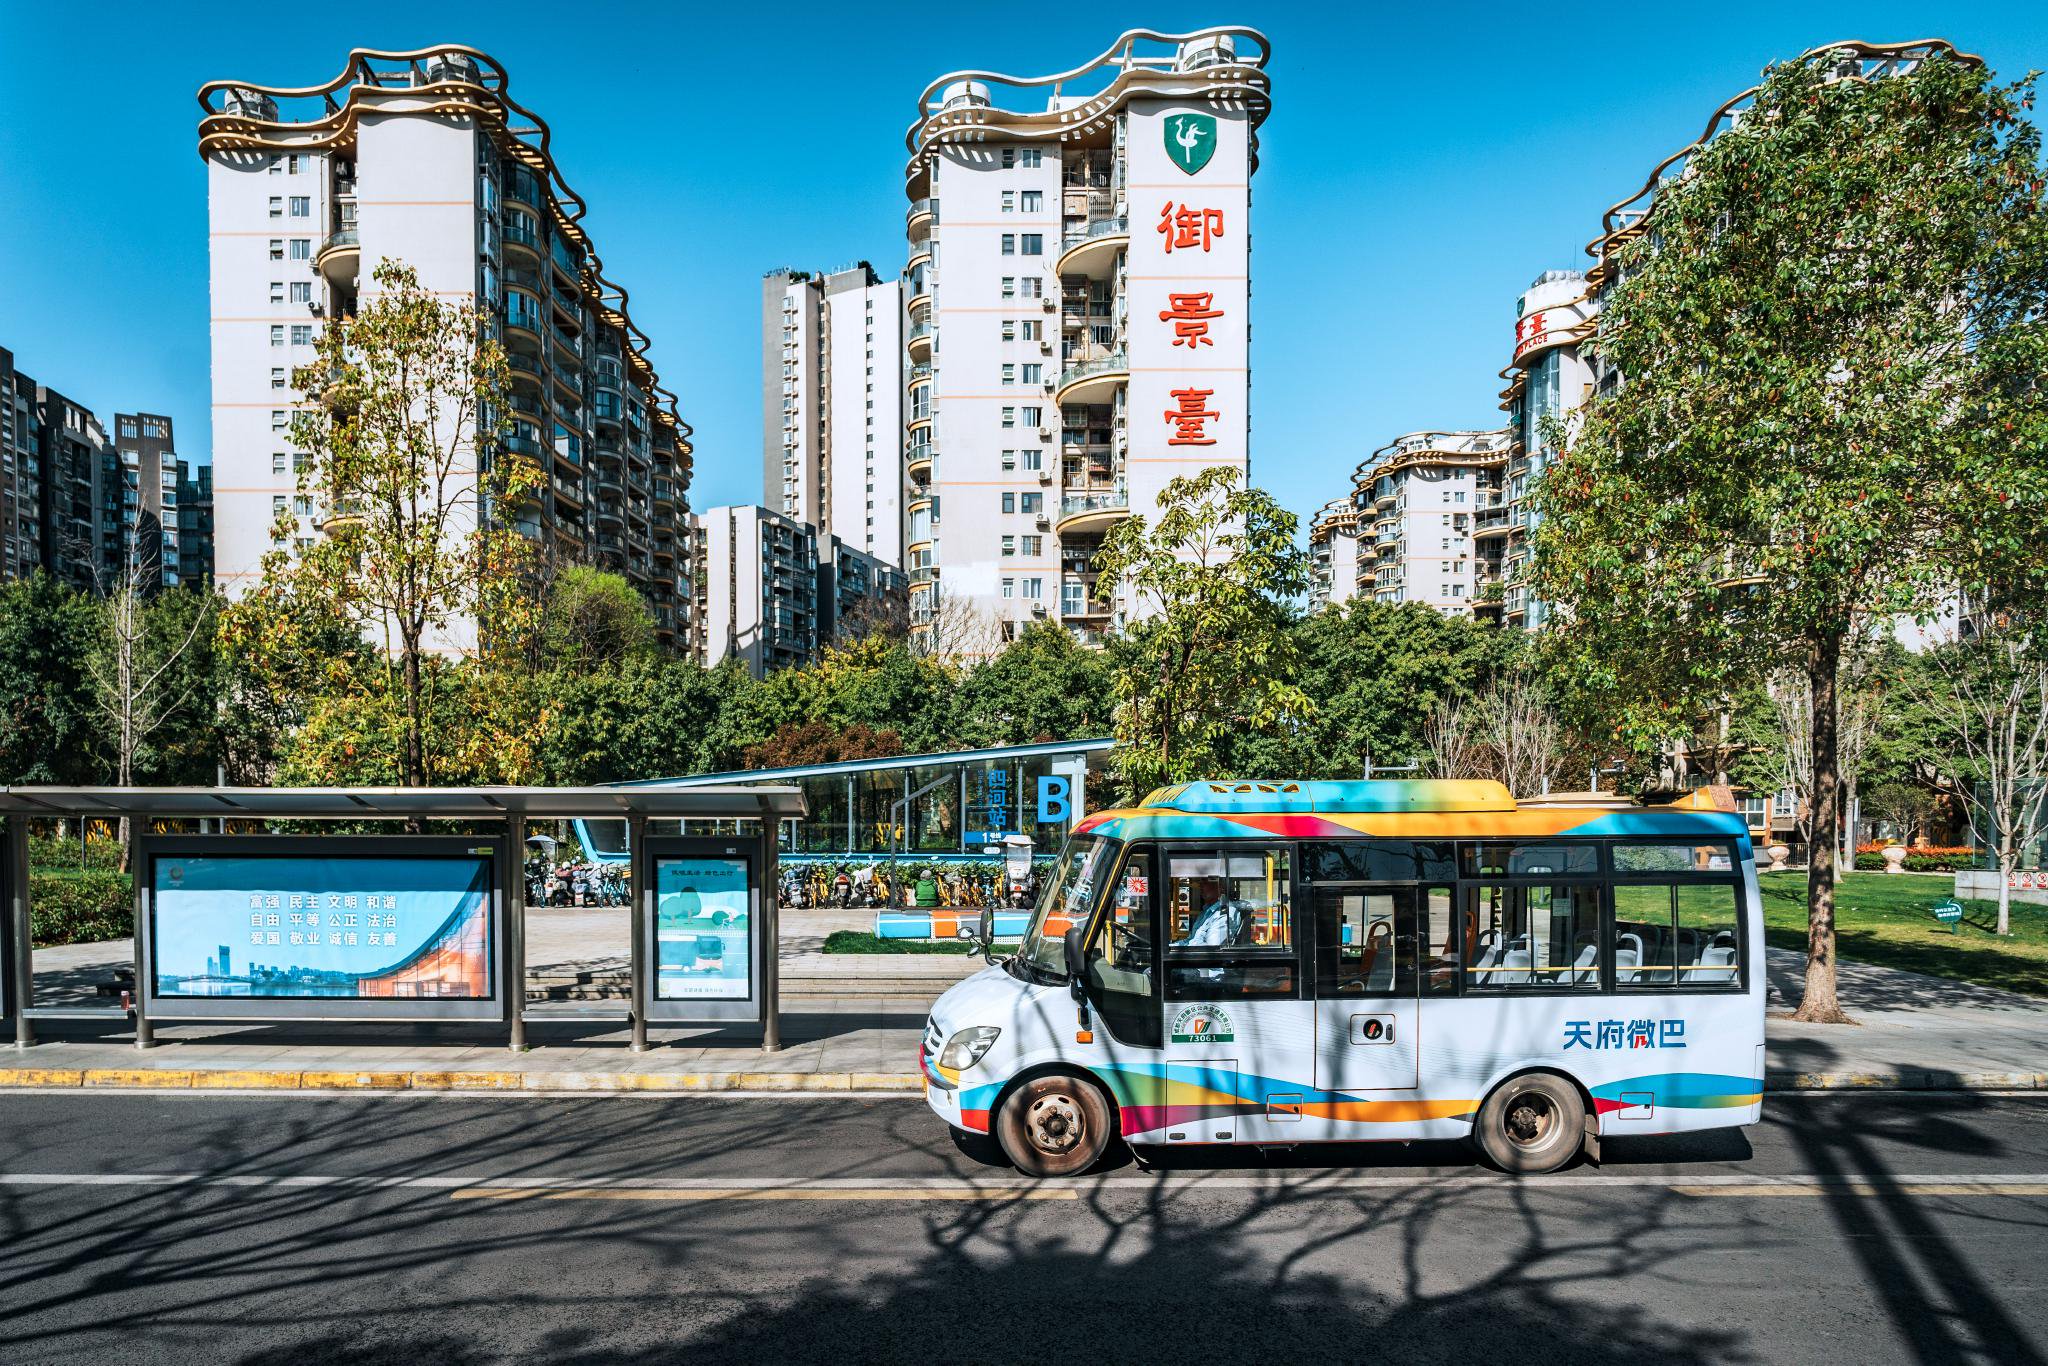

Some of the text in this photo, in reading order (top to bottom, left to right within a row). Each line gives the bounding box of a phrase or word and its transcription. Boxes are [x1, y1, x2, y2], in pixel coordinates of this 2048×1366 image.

[1157, 200, 1224, 446] 御景臺
[988, 769, 1006, 826] 四河站
[1038, 776, 1071, 823] B
[250, 895, 397, 909] 富强 民主 文明 和谐
[250, 913, 397, 928] 自由 平等 公正 法治
[250, 931, 398, 946] 爱国 敬业 诚信 友善
[1563, 1019, 1687, 1050] 天府微巴
